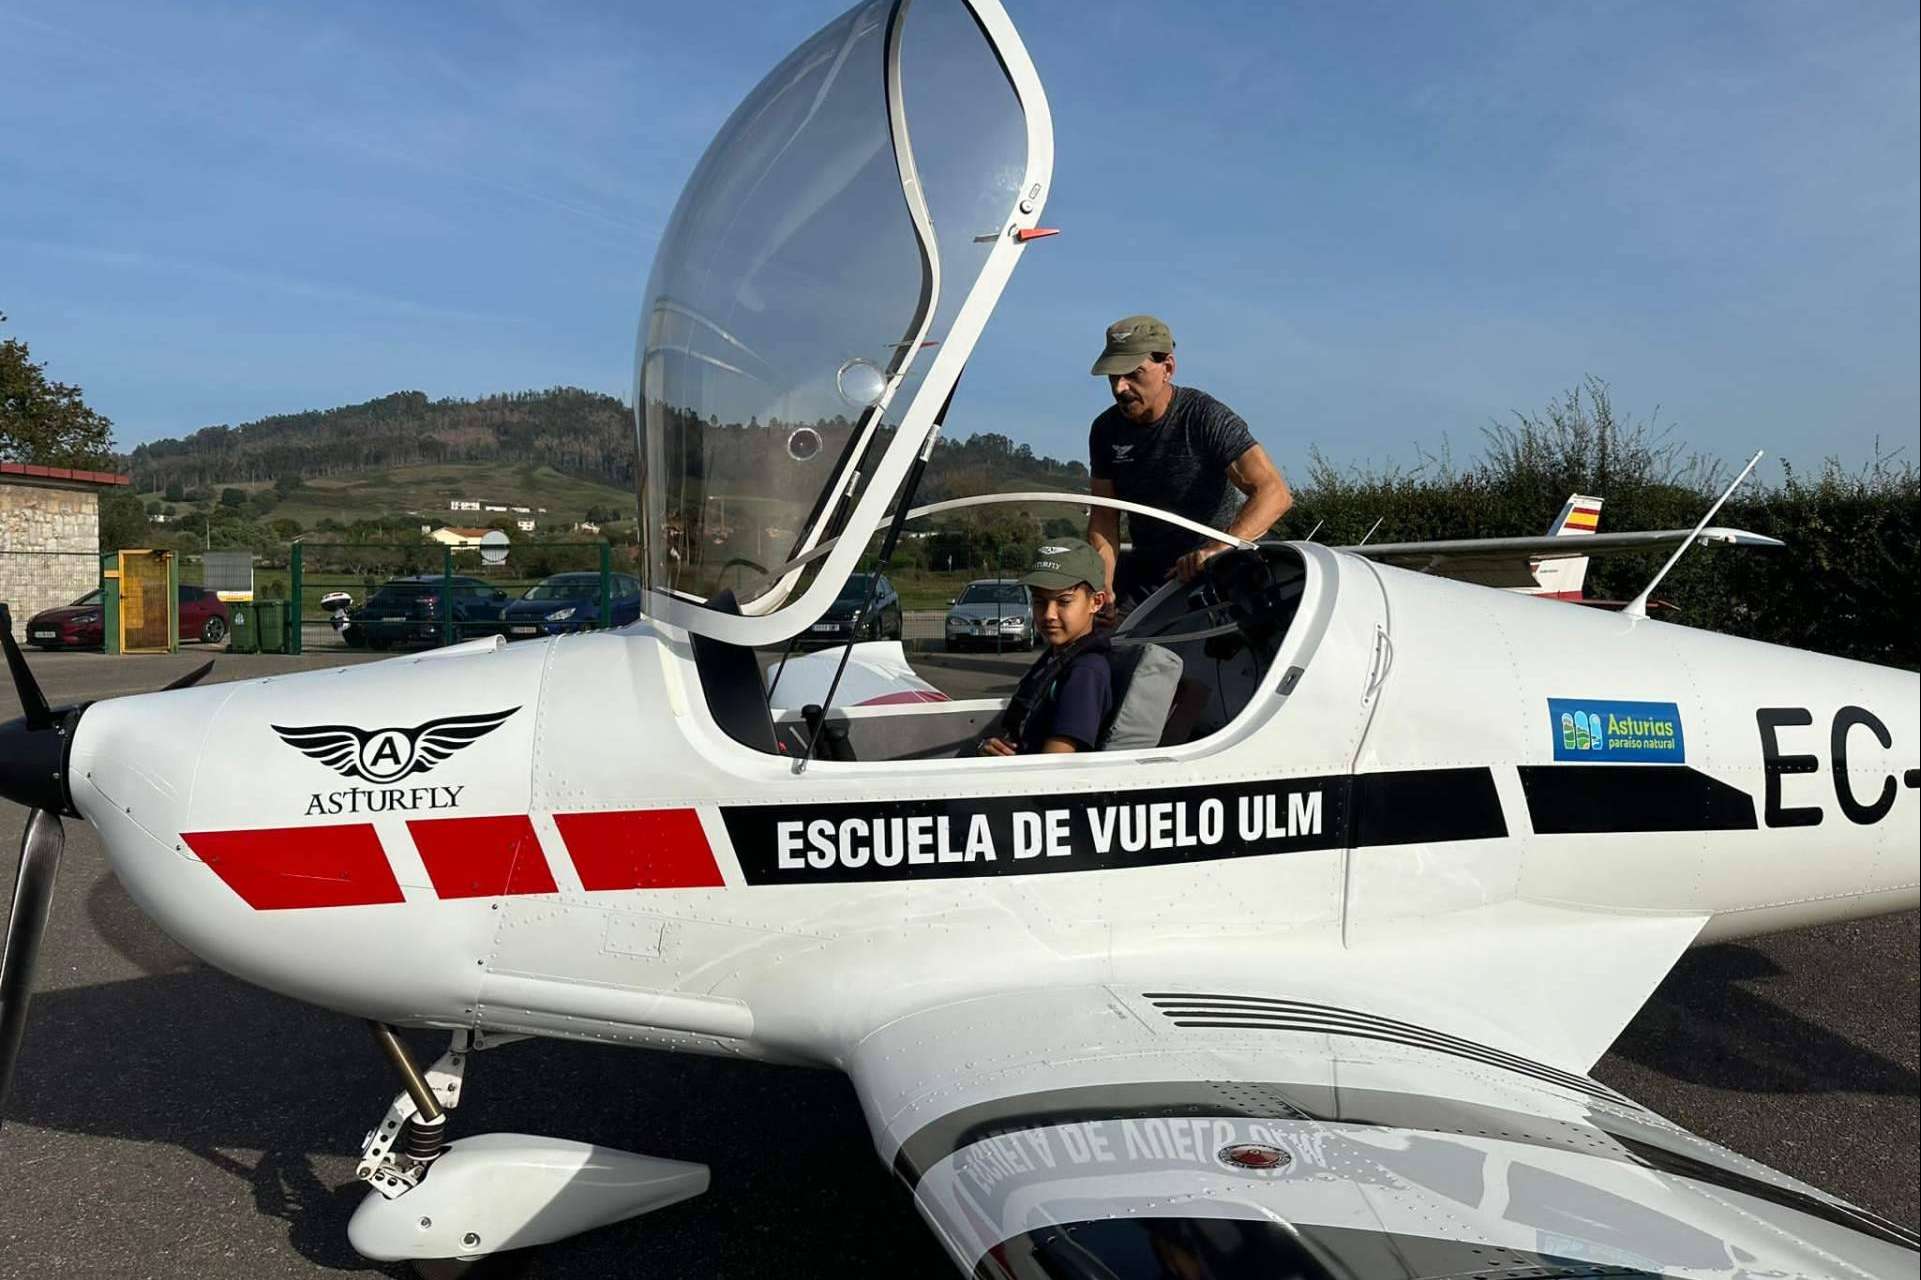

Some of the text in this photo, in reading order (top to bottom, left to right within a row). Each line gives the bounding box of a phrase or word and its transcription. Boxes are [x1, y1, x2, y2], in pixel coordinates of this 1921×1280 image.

[1607, 713, 1674, 737] Asturias
[370, 736, 402, 767] A
[1643, 738, 1676, 750] natural
[304, 785, 465, 816] ASTURFLY
[776, 790, 1323, 869] ESCUELA DE VUELO ULM
